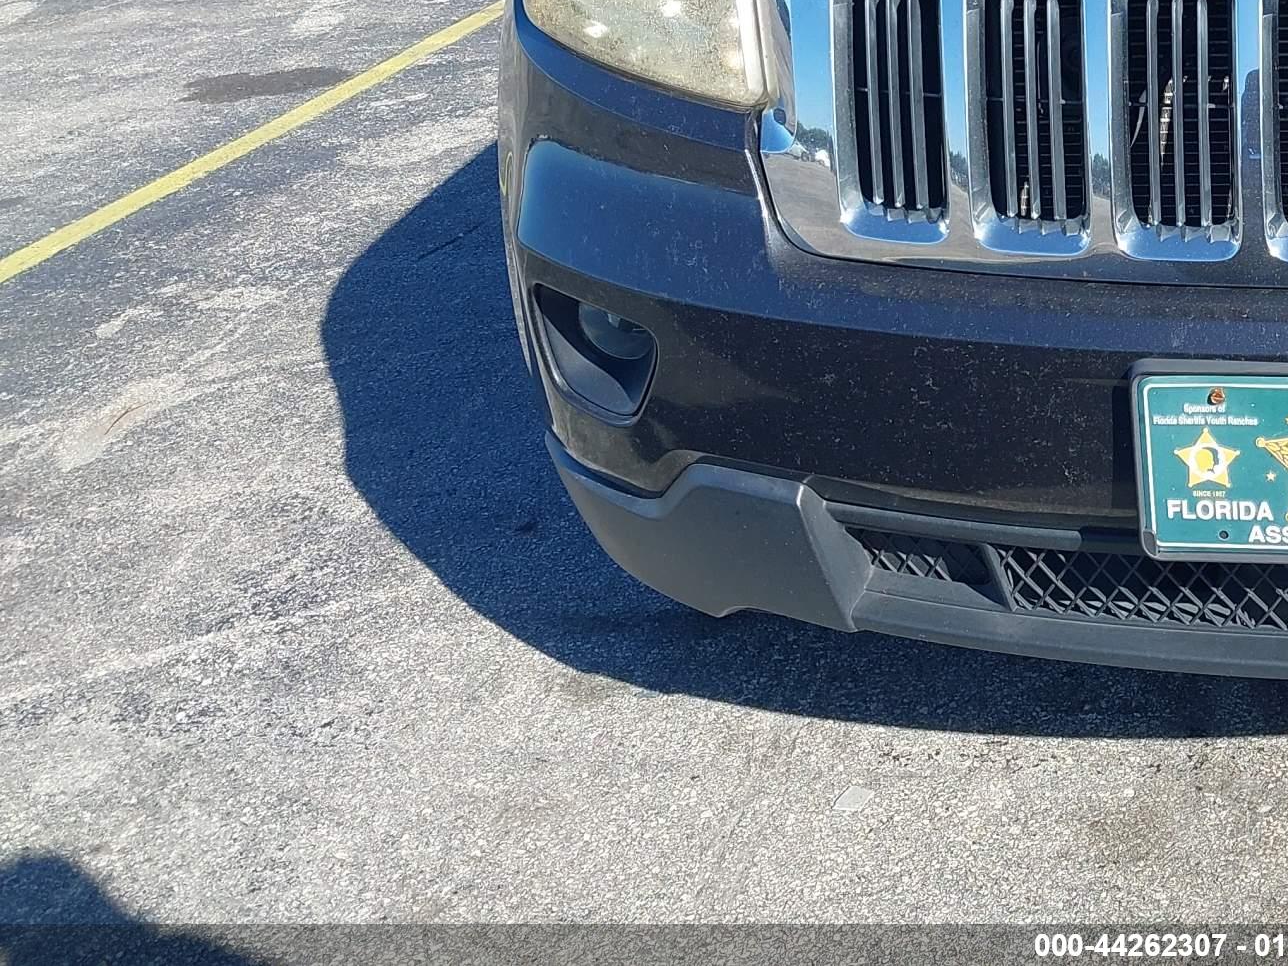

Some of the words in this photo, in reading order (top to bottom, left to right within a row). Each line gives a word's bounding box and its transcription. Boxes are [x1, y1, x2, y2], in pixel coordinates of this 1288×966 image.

[1153, 415, 1177, 425] Florida
[1207, 416, 1227, 425] Youth
[1228, 416, 1258, 426] Ranches
[1167, 499, 1274, 521] FLORIDA
